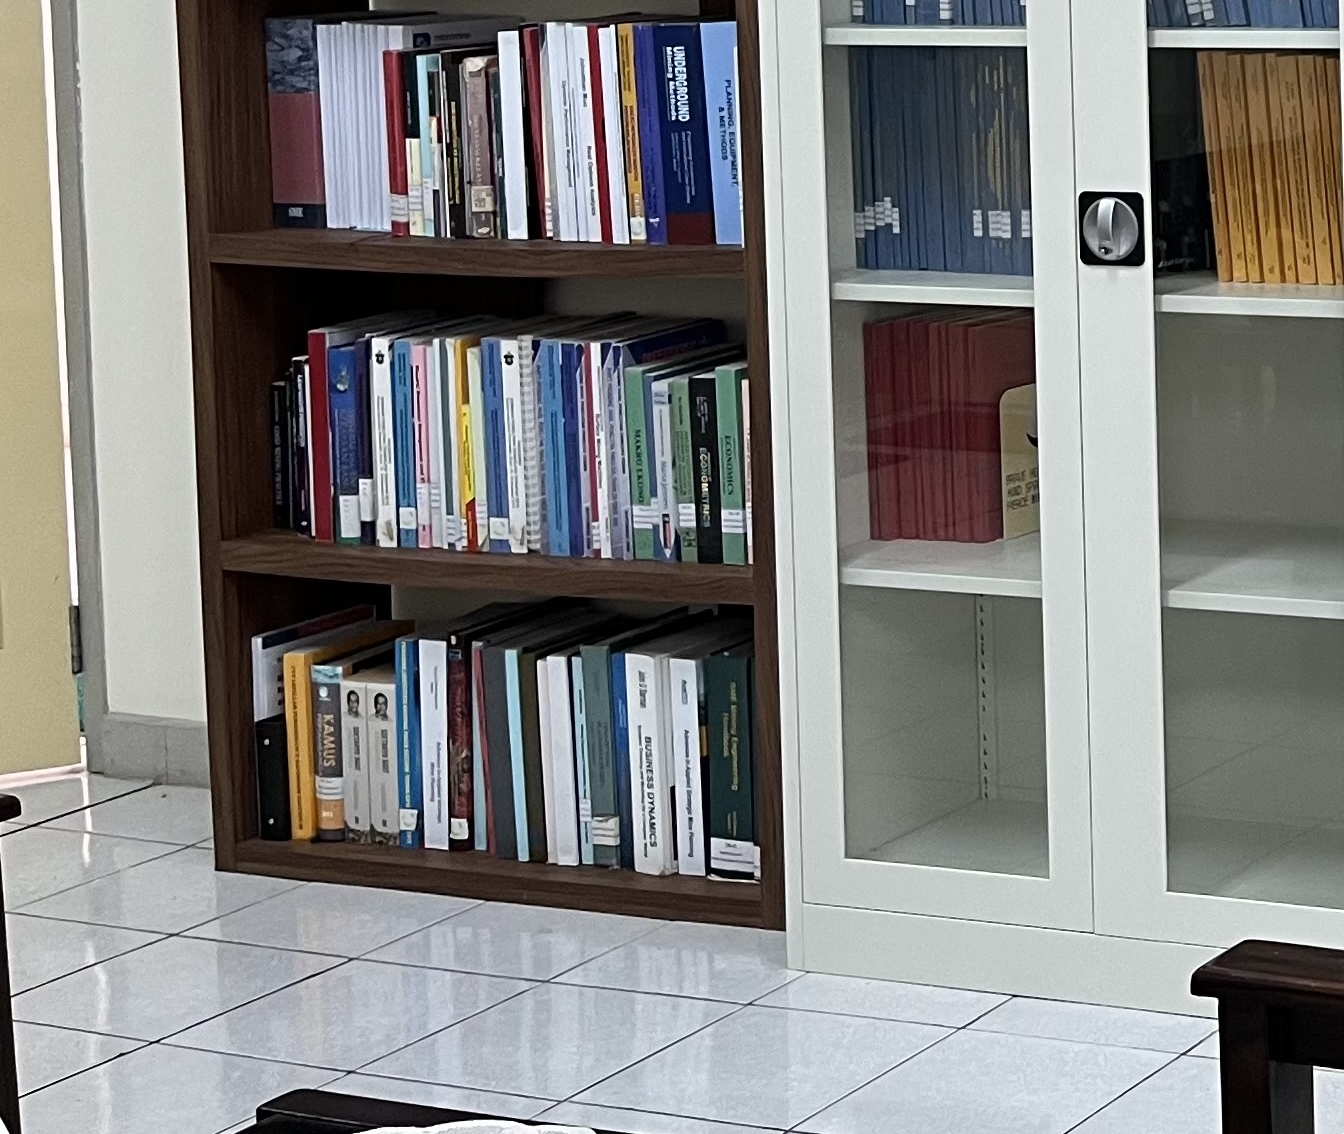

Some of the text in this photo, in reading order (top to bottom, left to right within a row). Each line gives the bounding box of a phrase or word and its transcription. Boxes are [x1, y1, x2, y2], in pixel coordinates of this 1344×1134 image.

[674, 46, 690, 122] UNDERGROUND
[635, 429, 644, 465] MAKRO
[724, 435, 734, 495] ECONOMICS
[699, 447, 711, 527] ECONOMETRICS
[323, 714, 336, 767] KAMUS
[644, 736, 658, 848] BUSINESS DYNAMICS
